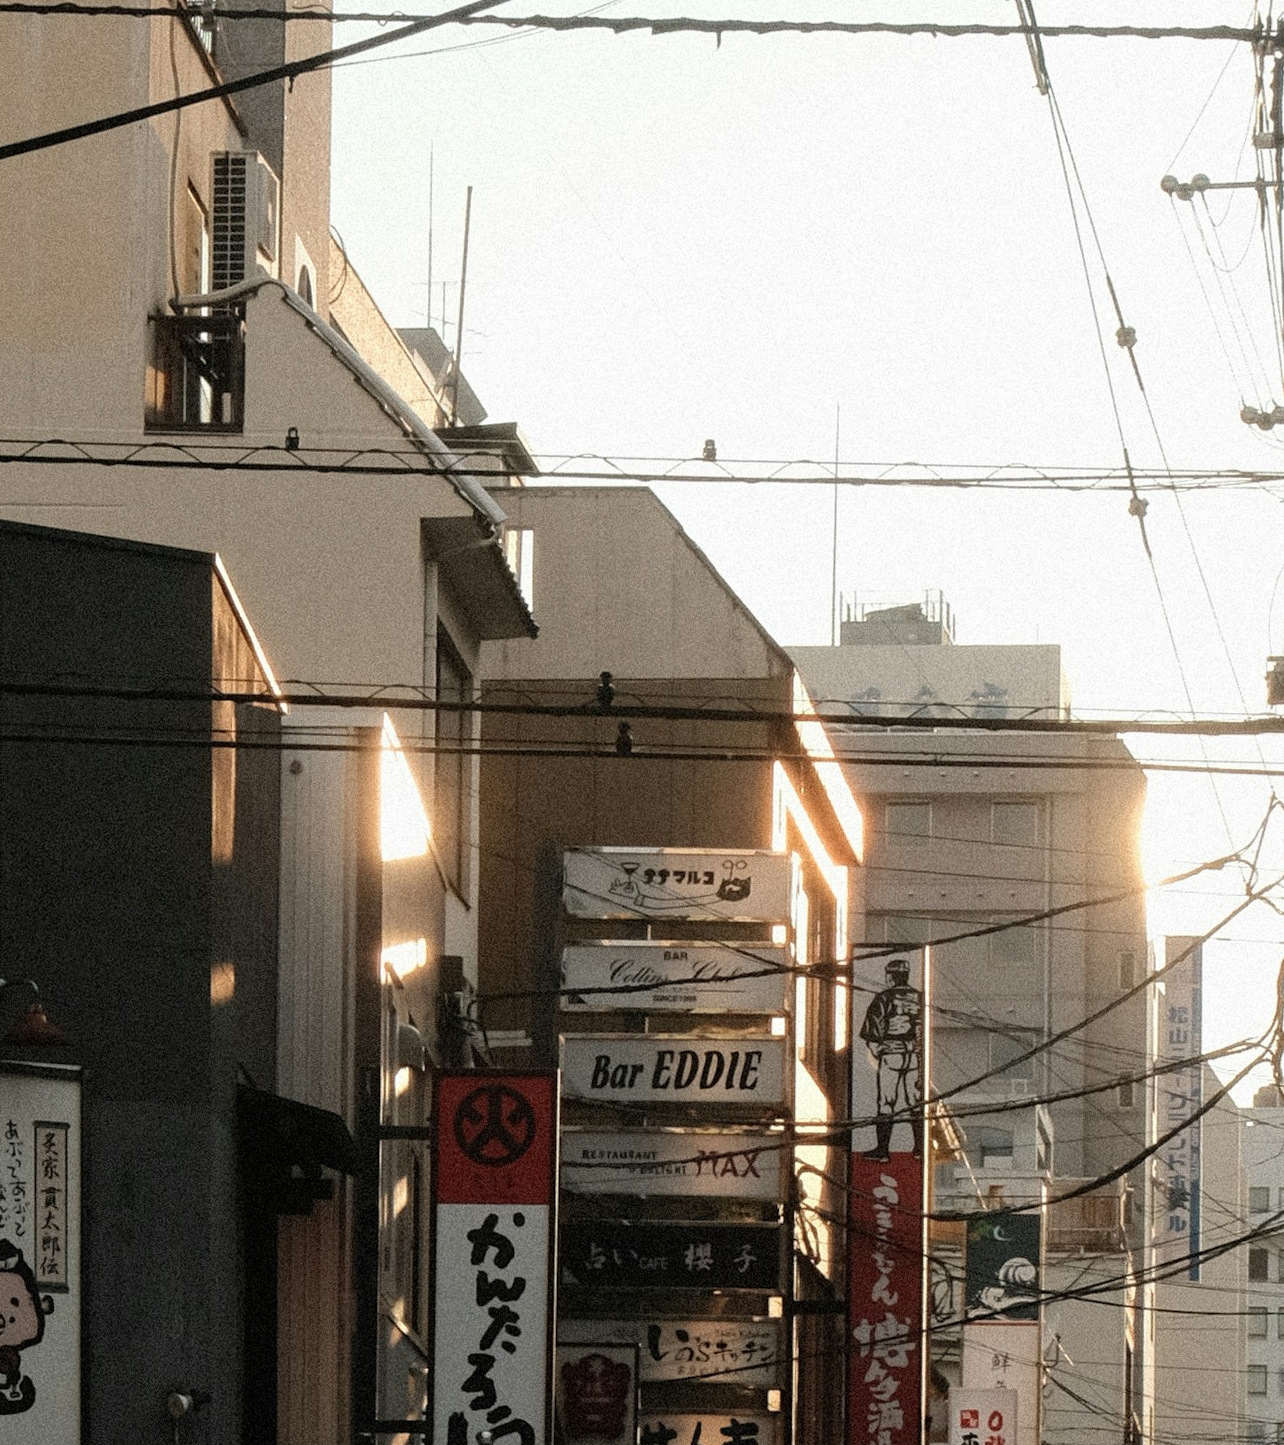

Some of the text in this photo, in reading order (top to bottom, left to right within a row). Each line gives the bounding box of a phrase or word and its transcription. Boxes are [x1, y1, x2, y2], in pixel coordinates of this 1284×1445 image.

[591, 1049, 763, 1090] Bar EDDIE
[695, 1149, 762, 1179] MAX
